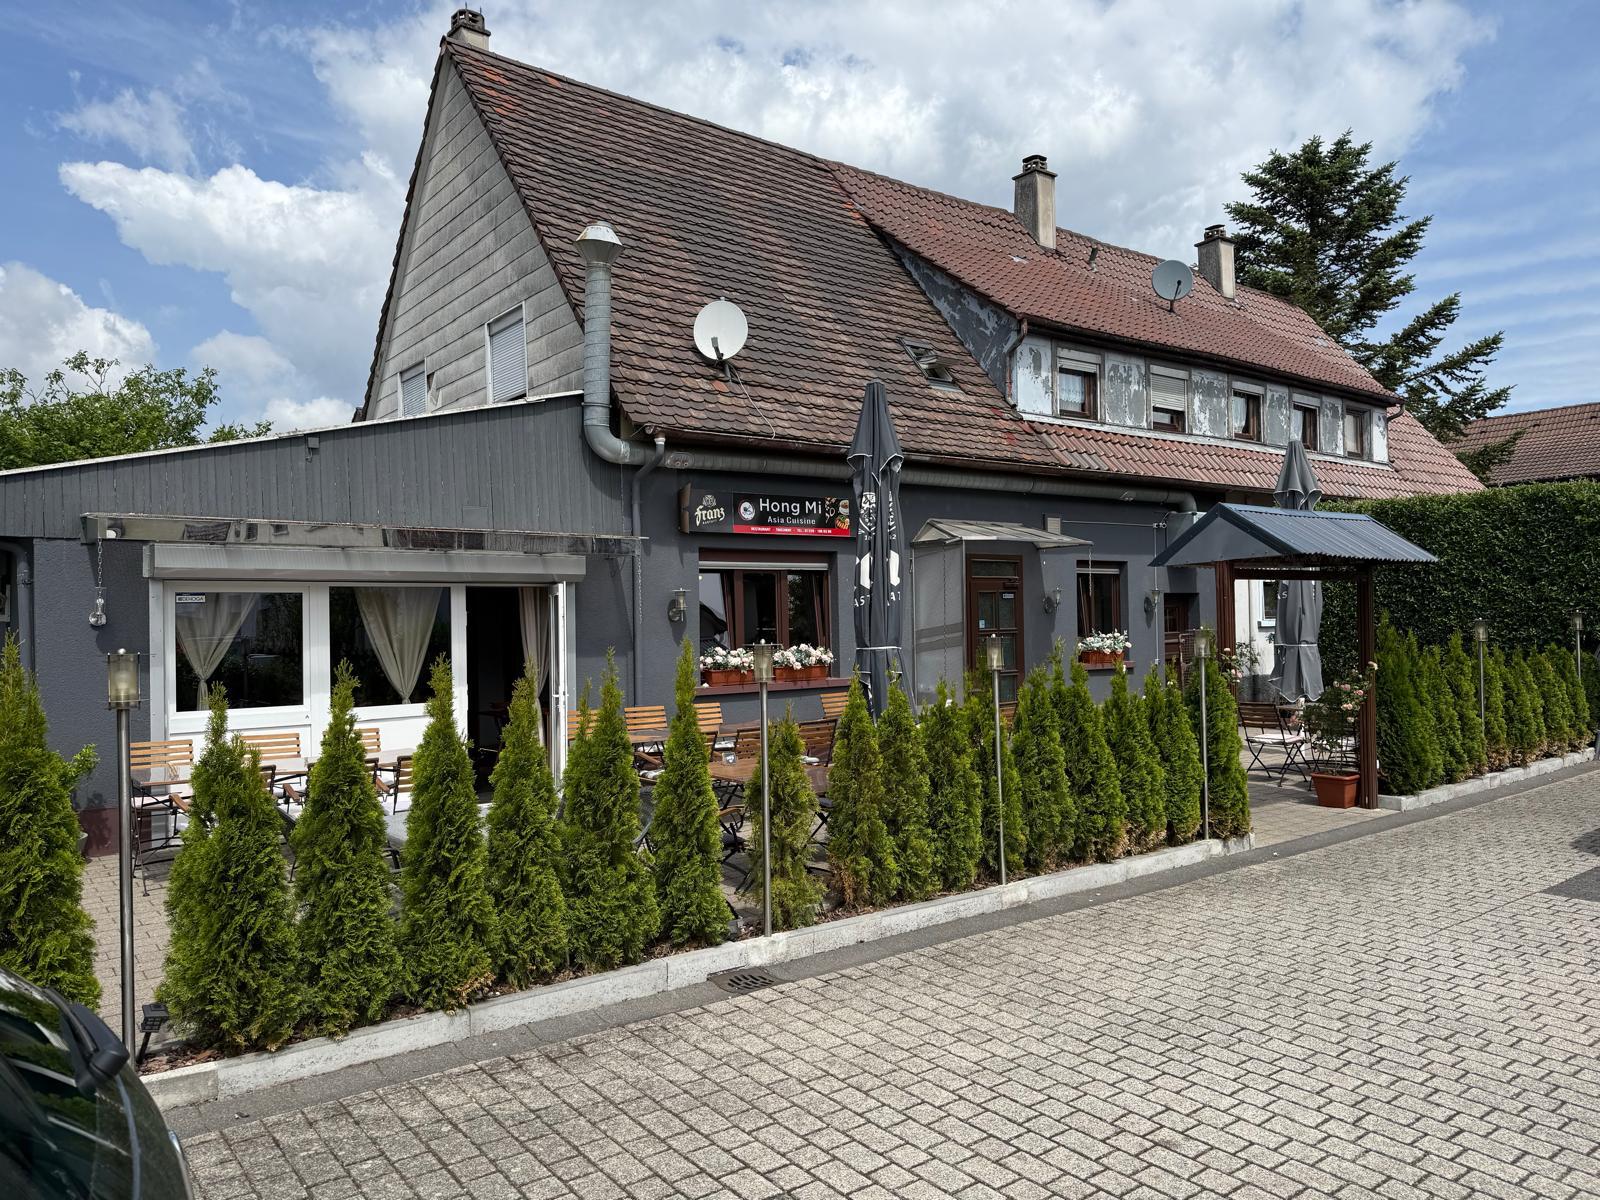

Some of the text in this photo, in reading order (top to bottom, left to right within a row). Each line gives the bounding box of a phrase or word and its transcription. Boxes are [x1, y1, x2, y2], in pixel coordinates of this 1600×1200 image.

[759, 498, 822, 516] Hong Mi
[767, 516, 816, 525] Asia Cuisine
